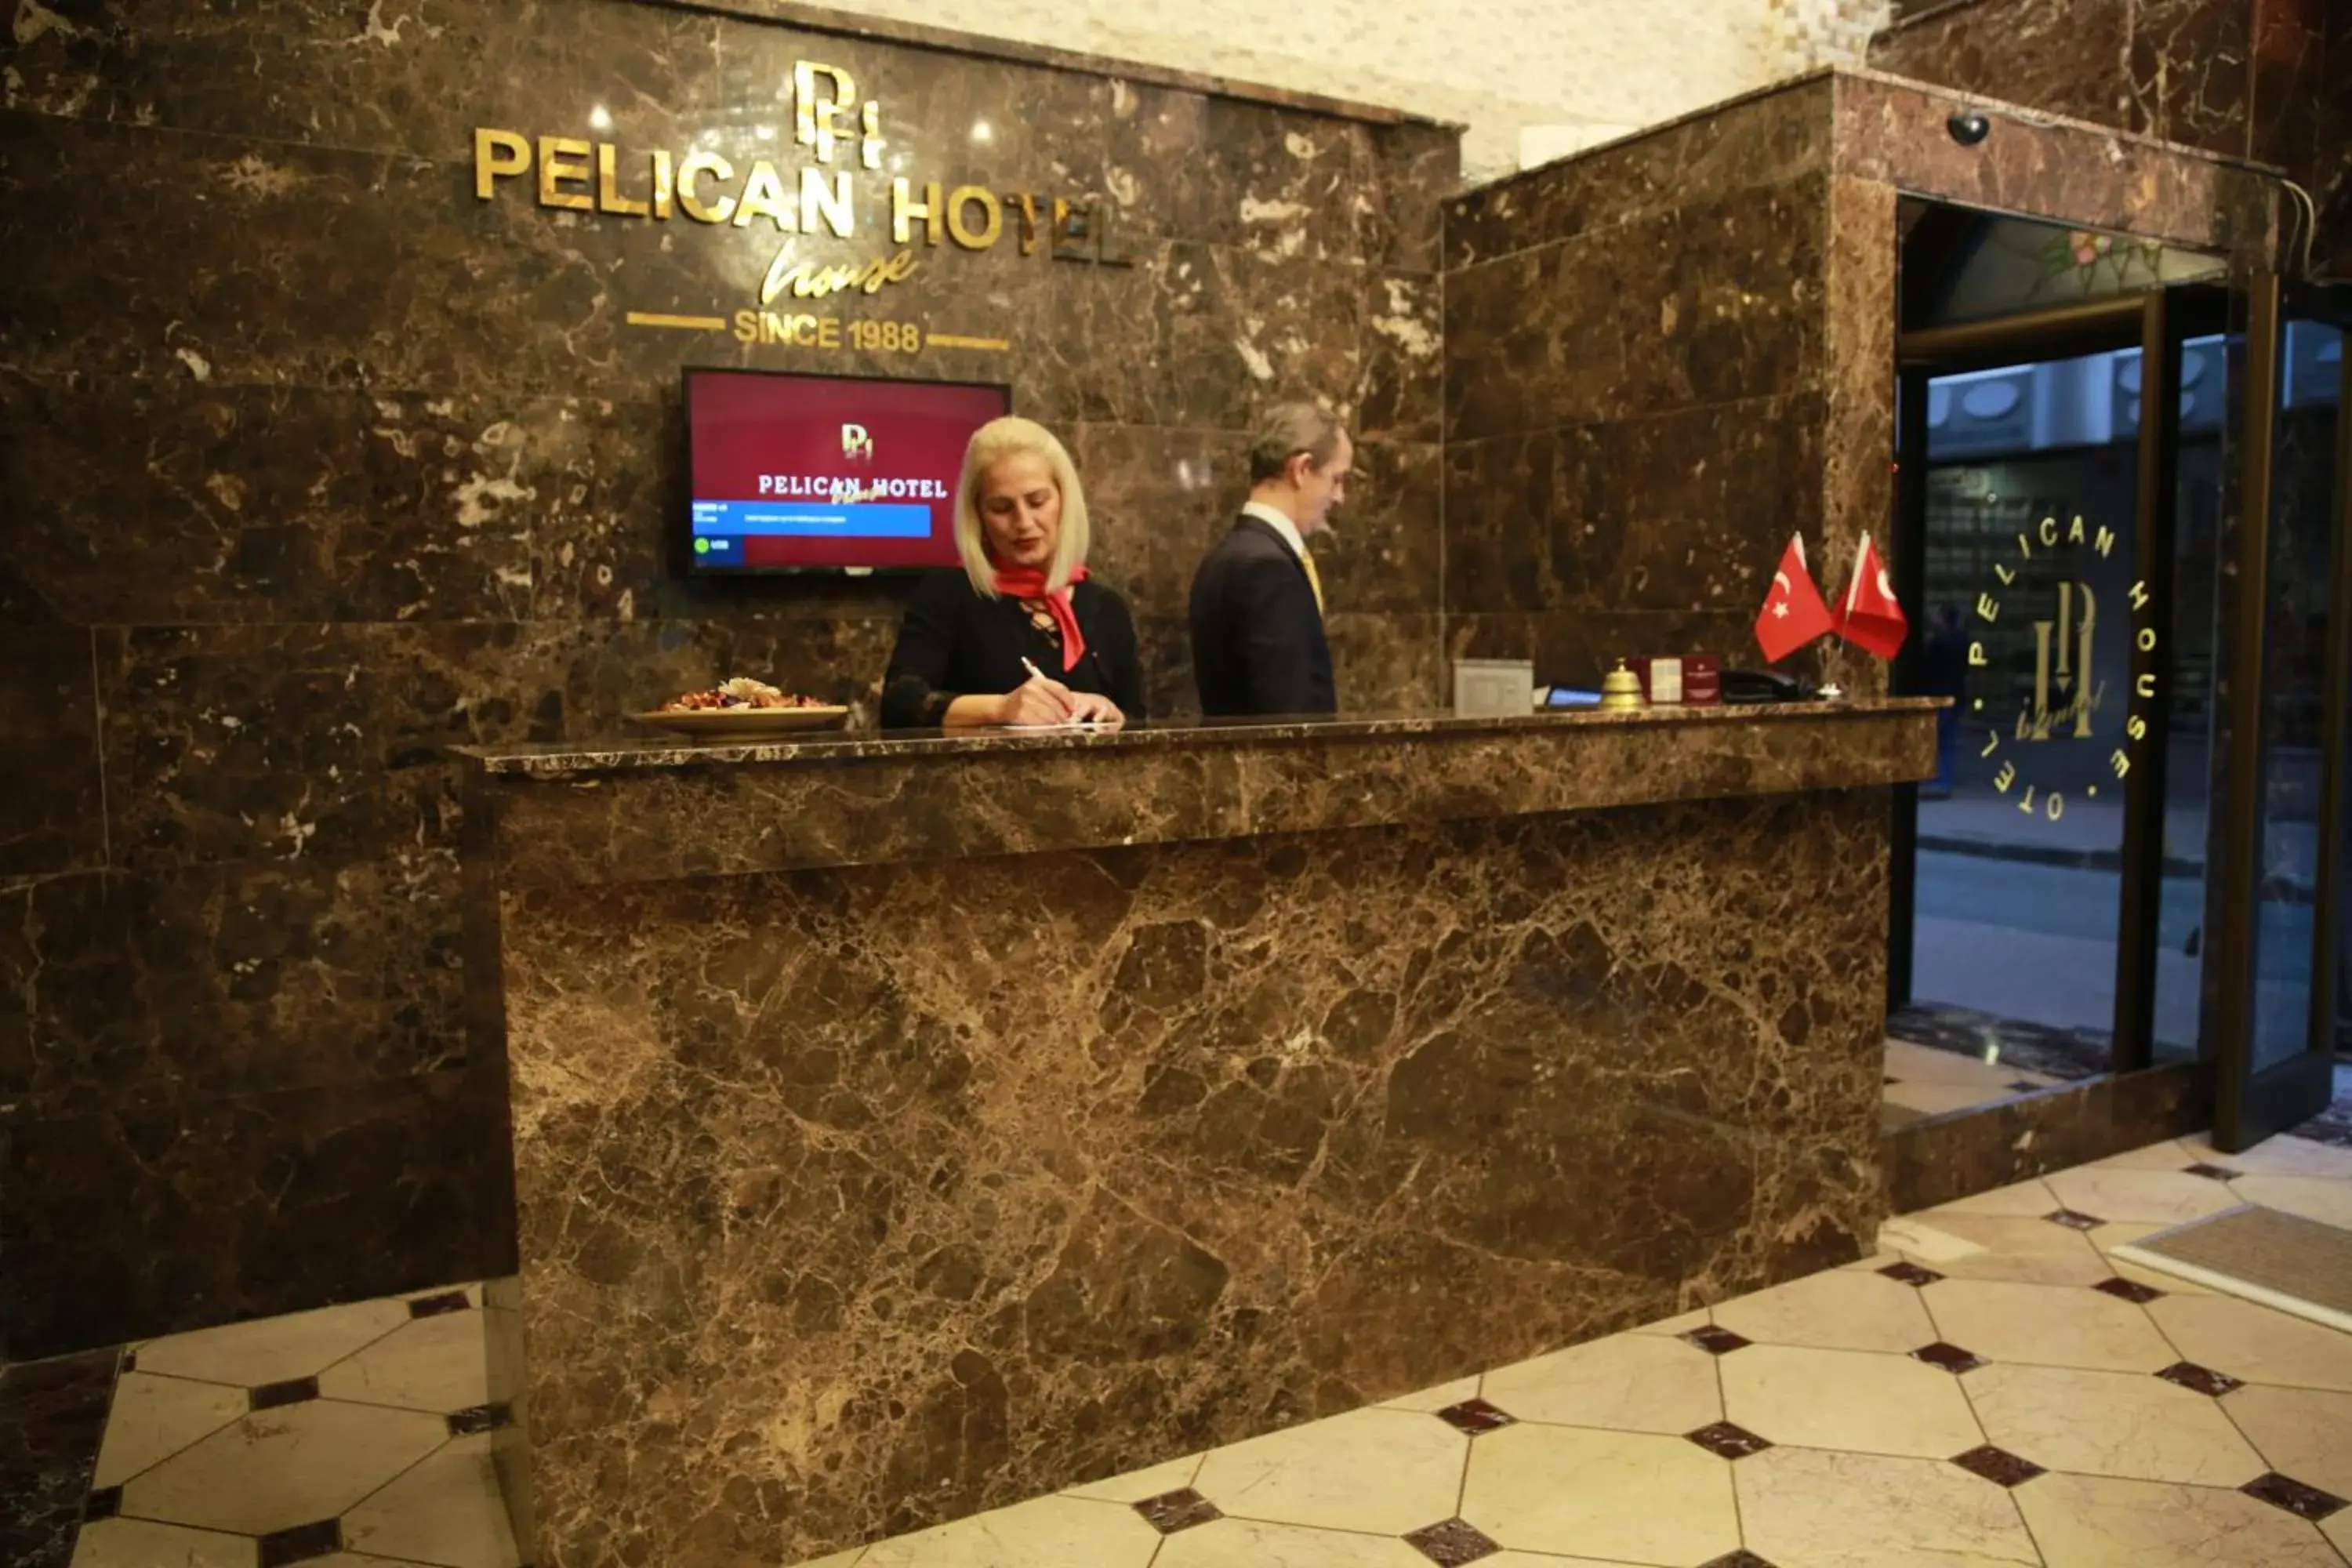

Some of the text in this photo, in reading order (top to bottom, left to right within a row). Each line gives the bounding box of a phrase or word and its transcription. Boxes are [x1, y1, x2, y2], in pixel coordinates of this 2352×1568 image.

[476, 127, 1133, 267] PELICAN HOTEL
[761, 238, 920, 304] house
[735, 309, 919, 353] SINCE 1988
[758, 475, 860, 497] PELICAN
[873, 478, 949, 499] HOTEL
[1969, 514, 2156, 821] PELICAN HOUSE OTEL
